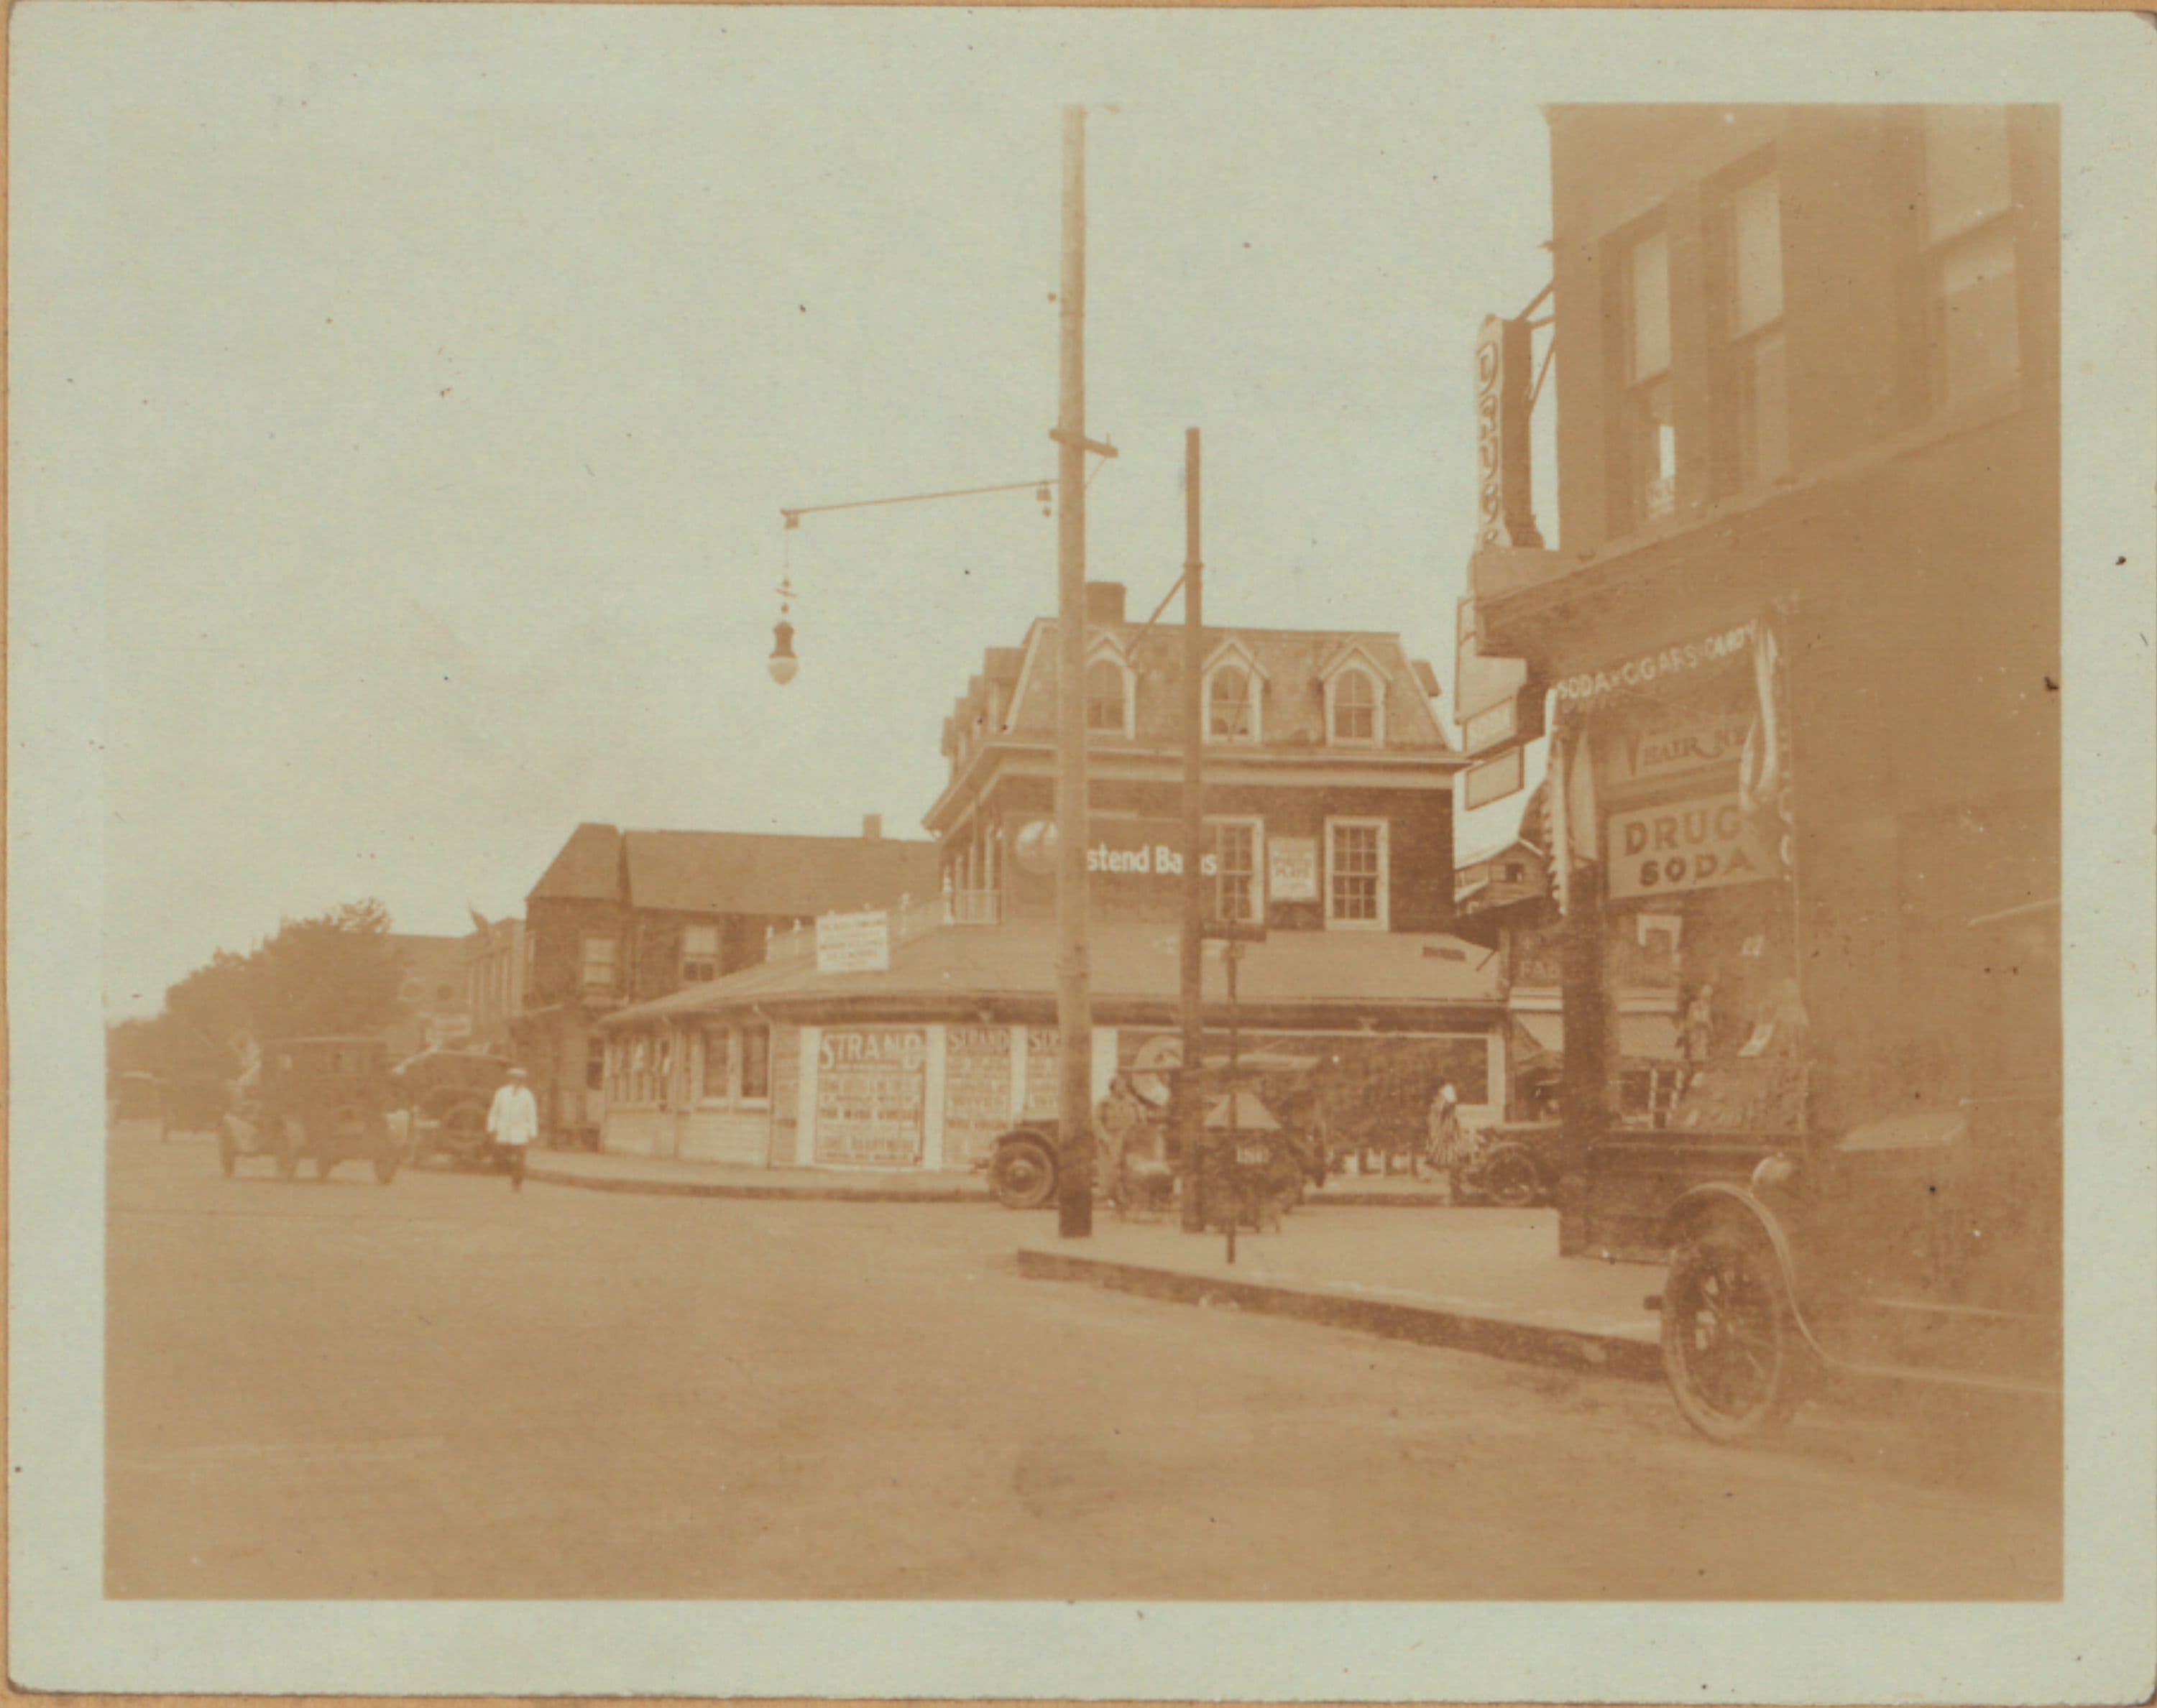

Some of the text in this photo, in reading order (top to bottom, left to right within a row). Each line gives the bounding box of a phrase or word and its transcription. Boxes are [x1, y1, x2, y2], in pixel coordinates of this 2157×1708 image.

[1086, 842, 1218, 876] stend Bas
[1639, 847, 1756, 887] SODA
[819, 1033, 922, 1070] STRAND
